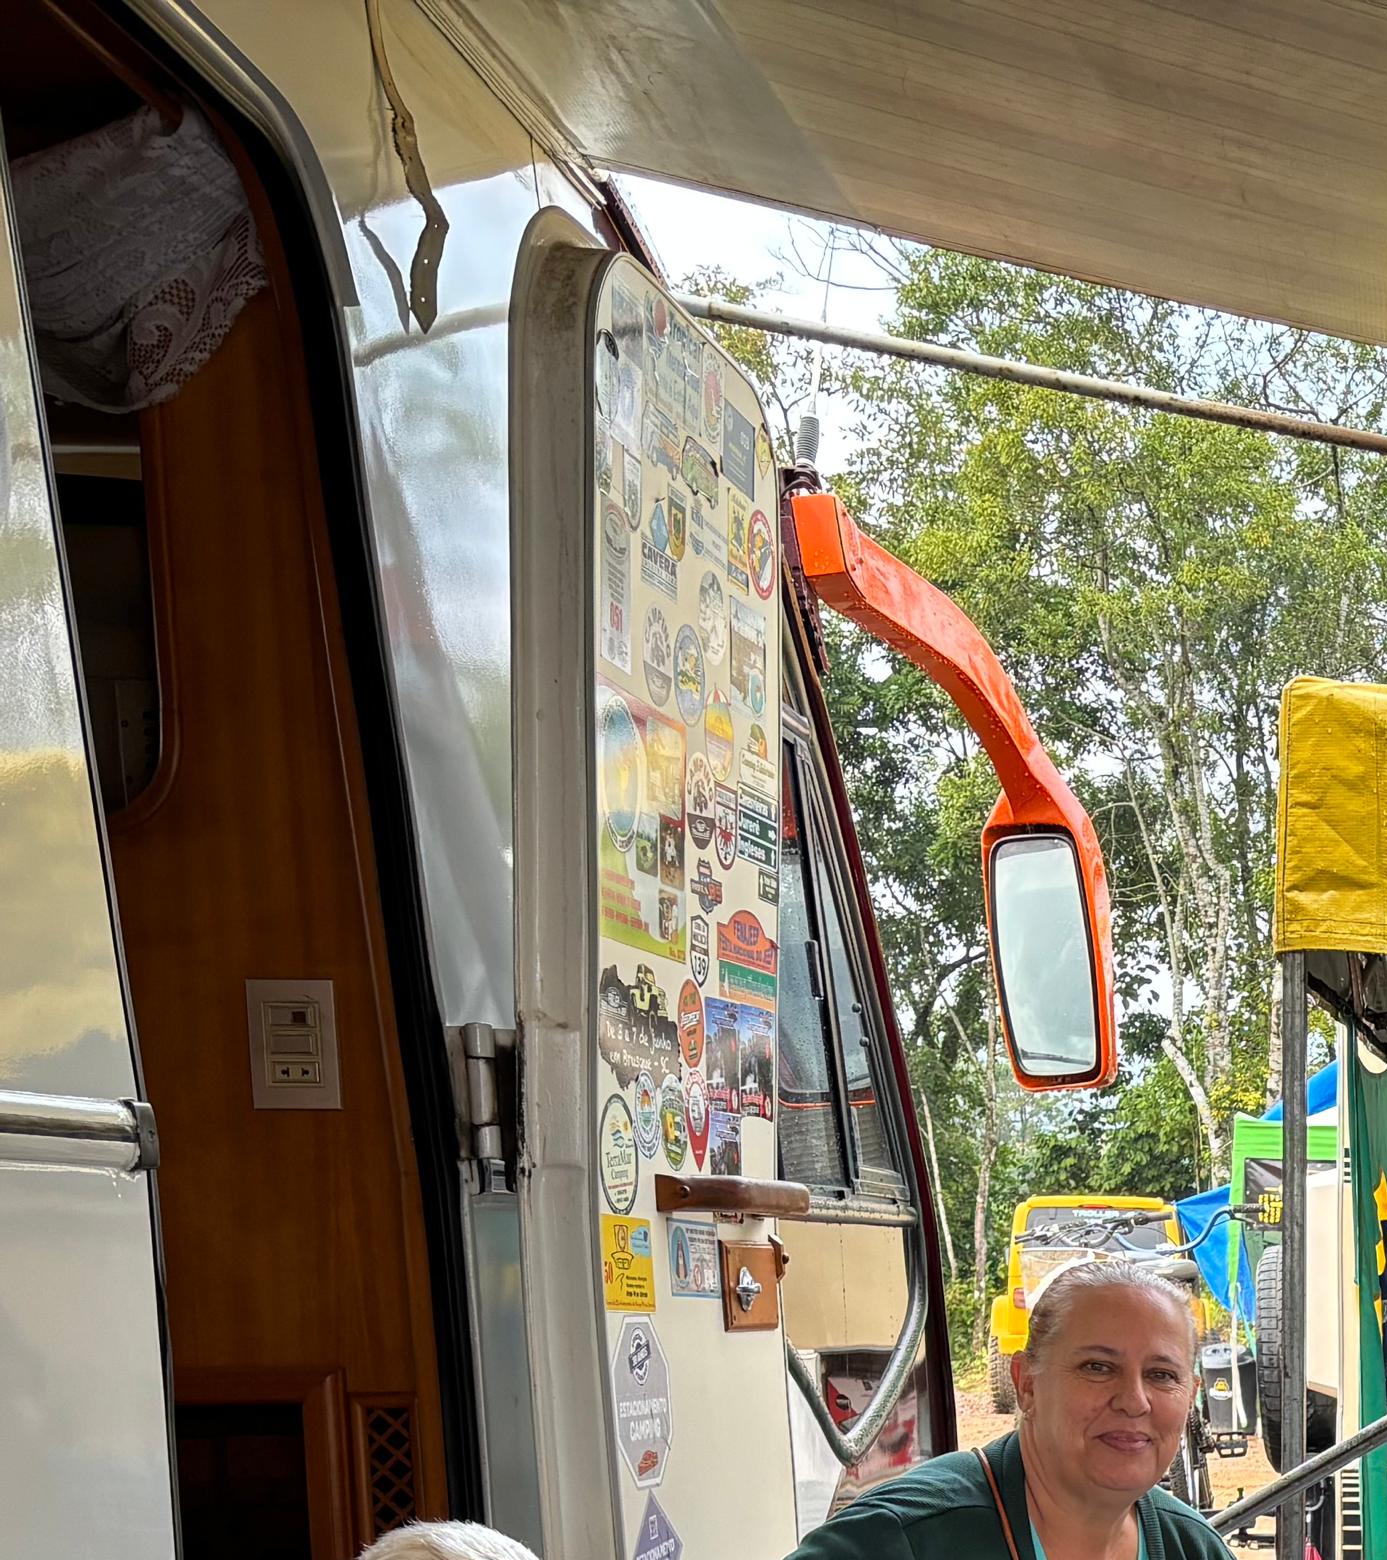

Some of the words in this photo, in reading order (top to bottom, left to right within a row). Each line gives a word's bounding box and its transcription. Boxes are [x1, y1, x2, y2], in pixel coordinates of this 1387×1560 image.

[694, 955, 706, 976] 139
[631, 1026, 637, 1044] 7
[638, 1025, 649, 1047] de
[622, 1048, 652, 1071] Brusque
[619, 1398, 668, 1418] ESTACIONAMENTO
[629, 1418, 661, 1441] CAMPING
